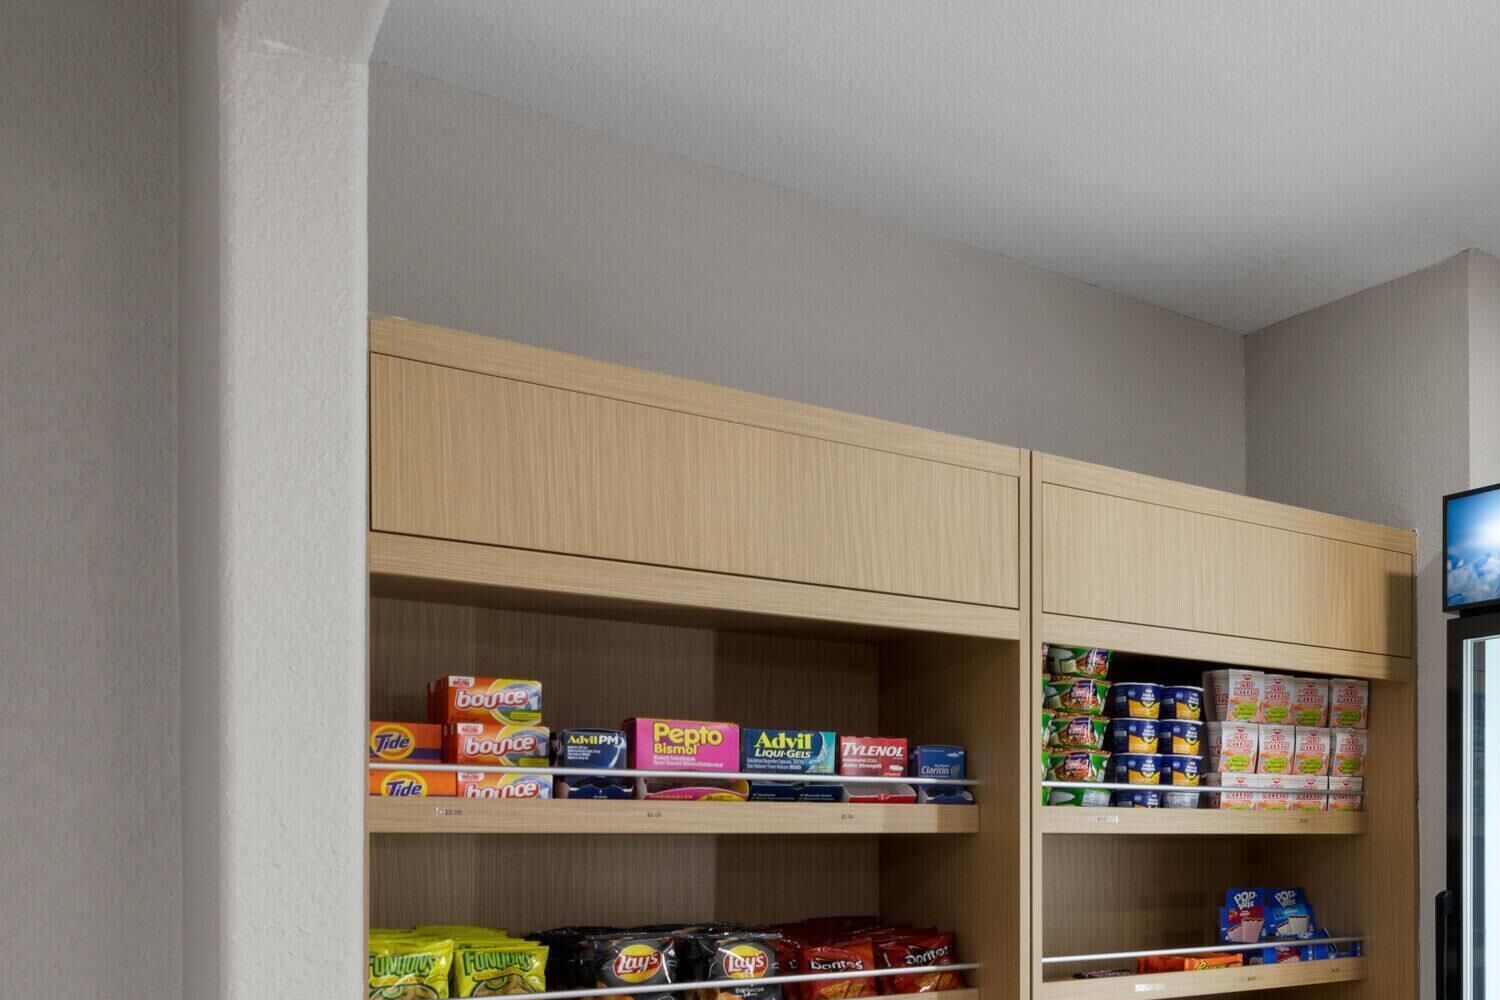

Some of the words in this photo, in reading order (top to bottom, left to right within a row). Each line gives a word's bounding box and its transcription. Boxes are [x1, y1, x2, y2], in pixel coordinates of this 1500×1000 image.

[456, 688, 529, 711] bounce
[374, 733, 411, 752] Tide
[568, 735, 598, 745] Advil
[599, 735, 619, 745] PM
[653, 721, 724, 746] Pepto
[754, 731, 813, 750] Advil
[464, 735, 539, 758] bounce
[654, 743, 698, 755] Bismol
[842, 742, 904, 758] TYLENOL
[921, 766, 949, 775] Claritin
[386, 780, 423, 797] Tide
[462, 951, 534, 977] FUNYUNS
[617, 950, 661, 974] Lay's
[728, 952, 765, 972] Lay's
[810, 958, 864, 972] Doritos
